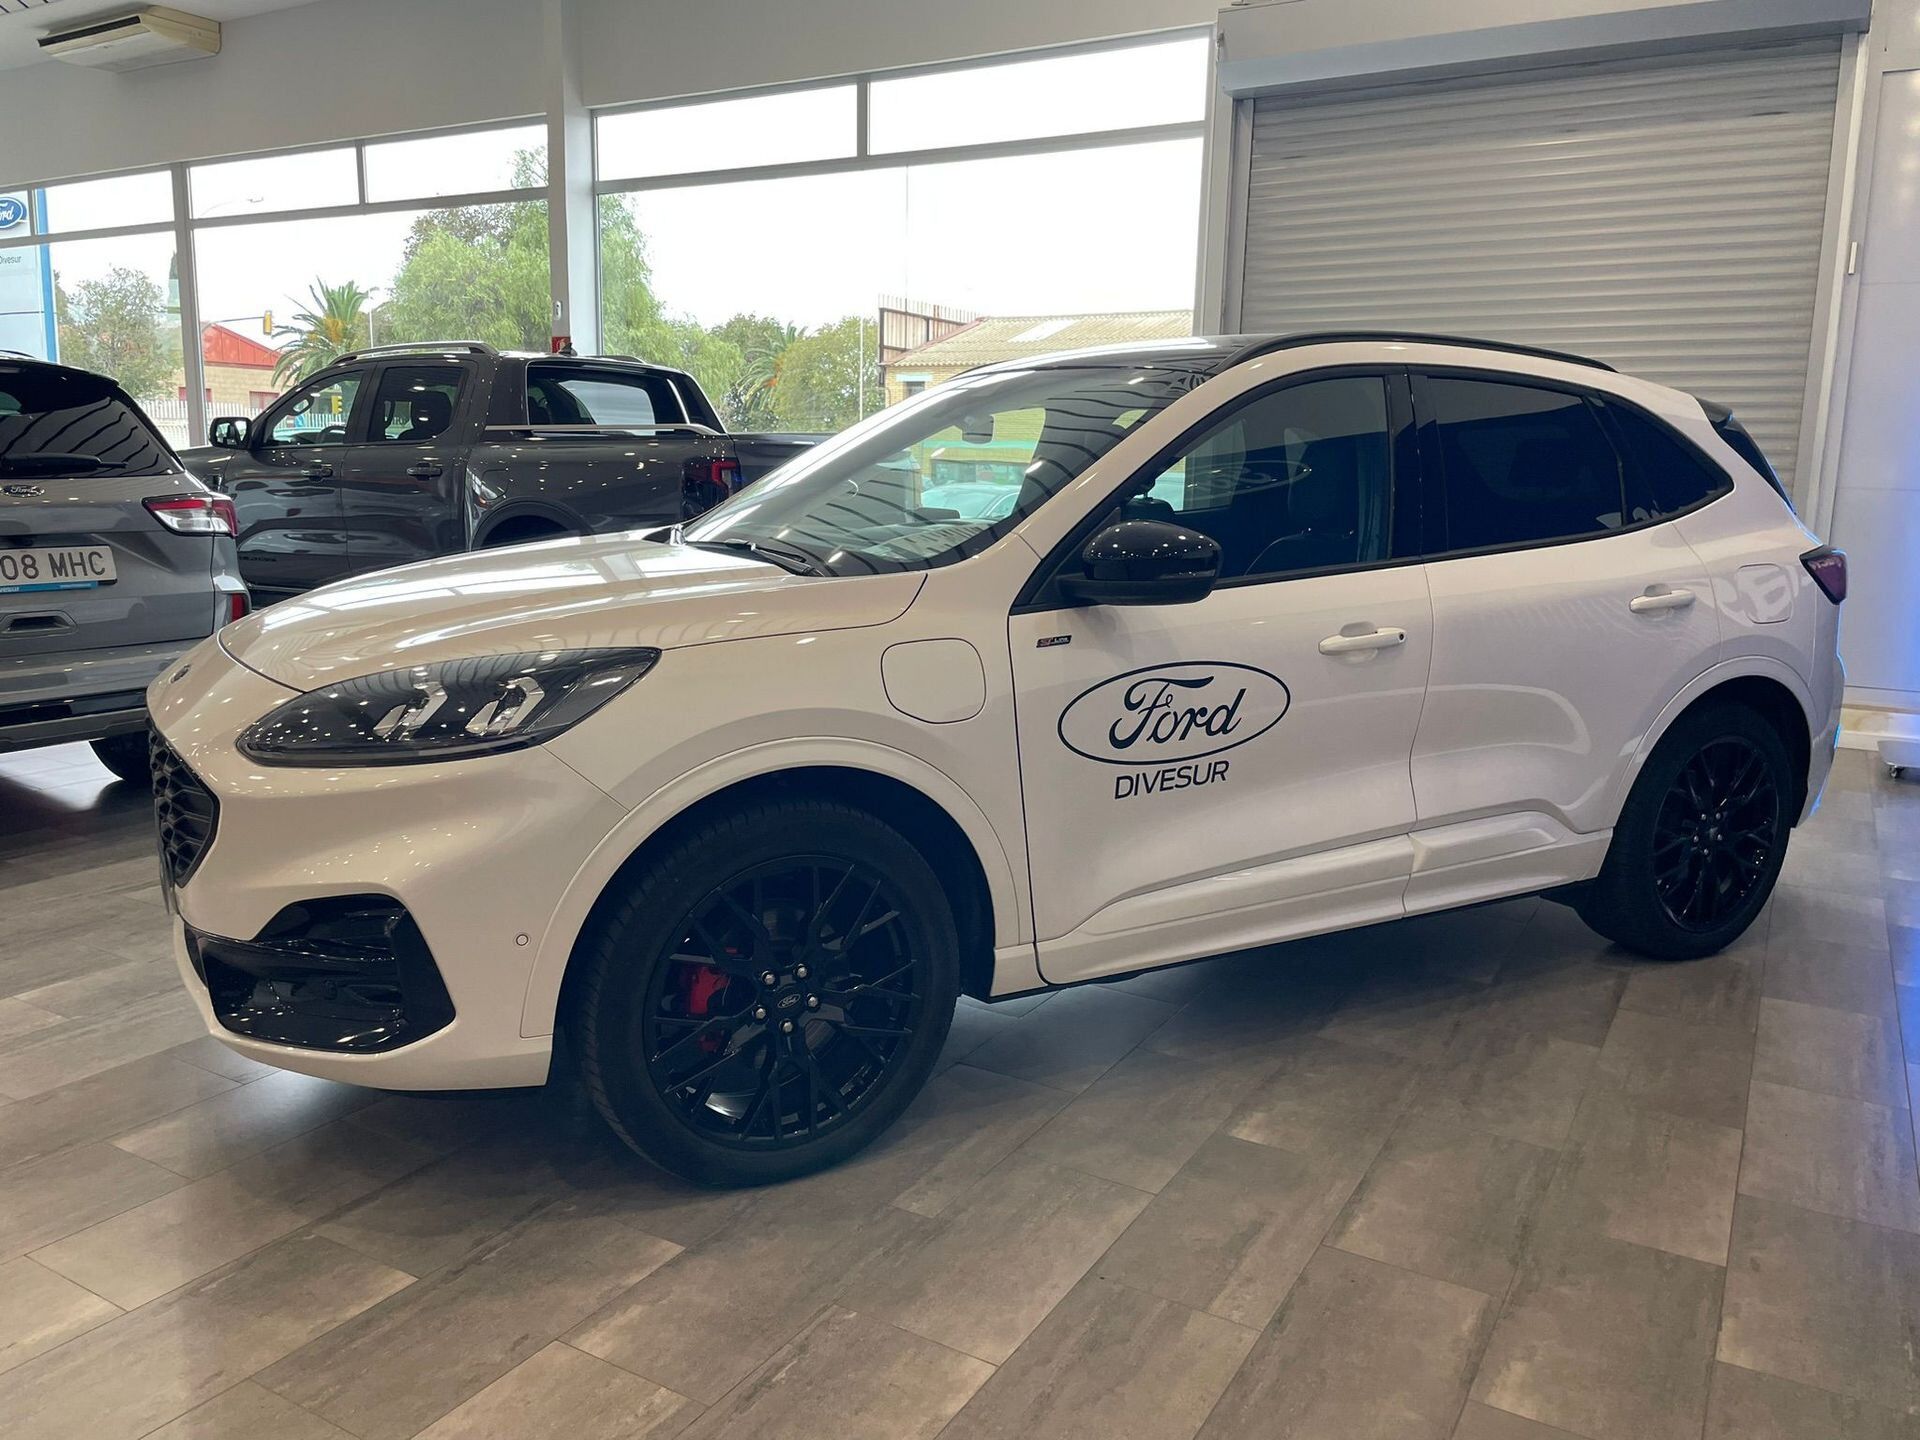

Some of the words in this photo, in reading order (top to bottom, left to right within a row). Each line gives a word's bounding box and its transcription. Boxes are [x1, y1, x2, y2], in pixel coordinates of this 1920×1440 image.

[0, 554, 39, 580] 08
[48, 551, 105, 578] MHC
[1109, 676, 1247, 750] Ford
[1114, 760, 1230, 800] DIVESUR
